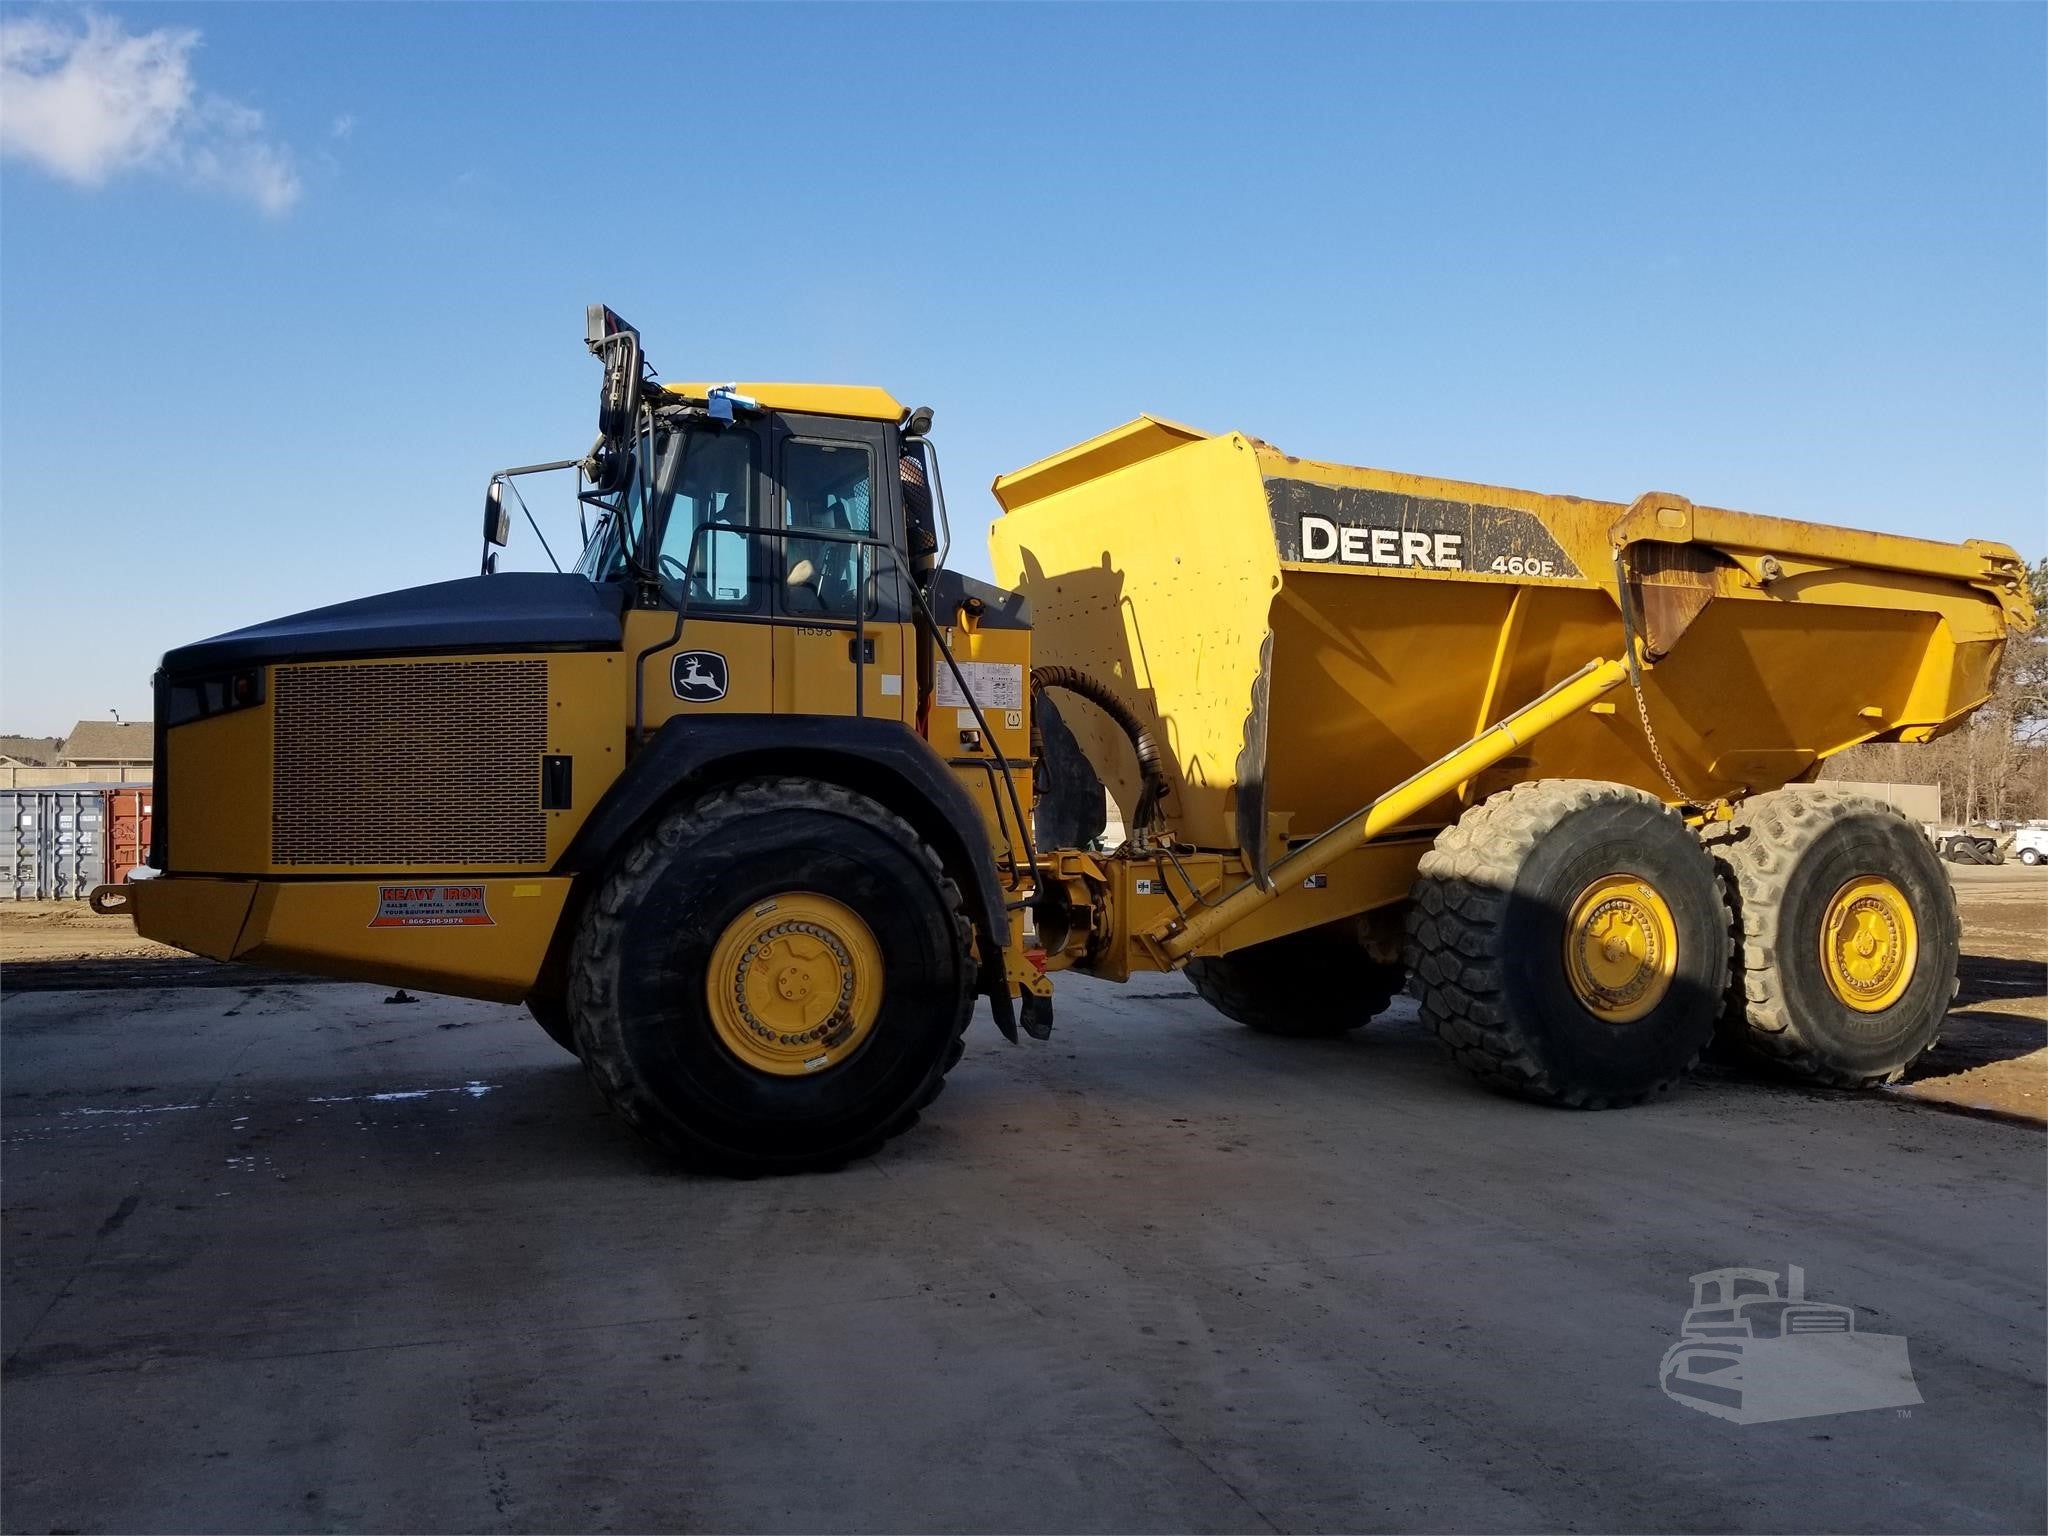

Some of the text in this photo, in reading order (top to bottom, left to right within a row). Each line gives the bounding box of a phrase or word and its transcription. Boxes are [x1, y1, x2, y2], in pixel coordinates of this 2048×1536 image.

[1301, 516, 1554, 576] DEERE 460E
[382, 887, 482, 901] HEAVY IRON
